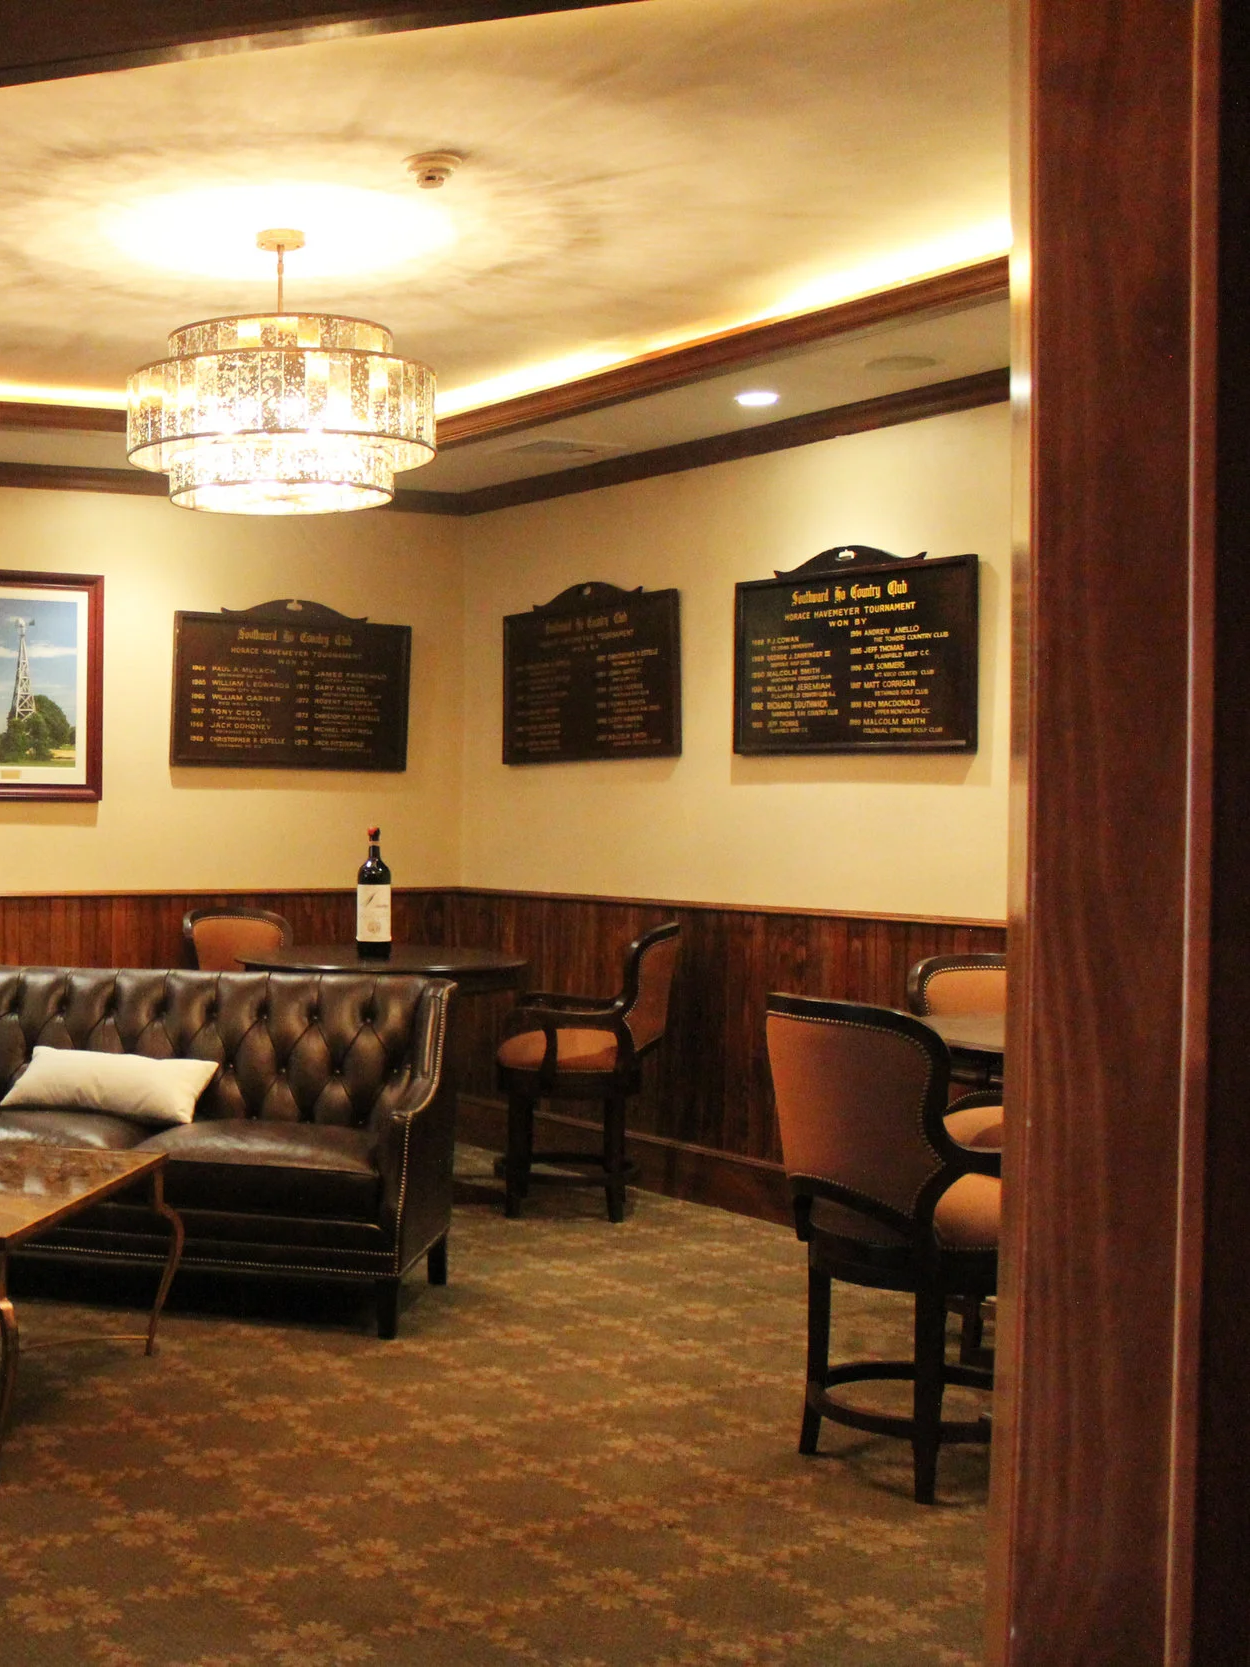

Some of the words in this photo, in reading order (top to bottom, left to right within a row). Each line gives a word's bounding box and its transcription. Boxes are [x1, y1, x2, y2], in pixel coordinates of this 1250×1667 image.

[791, 588, 829, 606] Southward
[850, 584, 881, 600] Country
[887, 580, 908, 597] Club
[784, 612, 810, 622] HORACE
[814, 607, 860, 619] HAVEMEYER
[864, 602, 916, 614] TOURNAMENT
[864, 628, 890, 636] ANDREW
[262, 648, 308, 657] HAVEMEYER
[797, 682, 830, 691] JEREMIAH
[882, 680, 916, 688] CORRIGAN
[878, 699, 920, 708] MACDONALD
